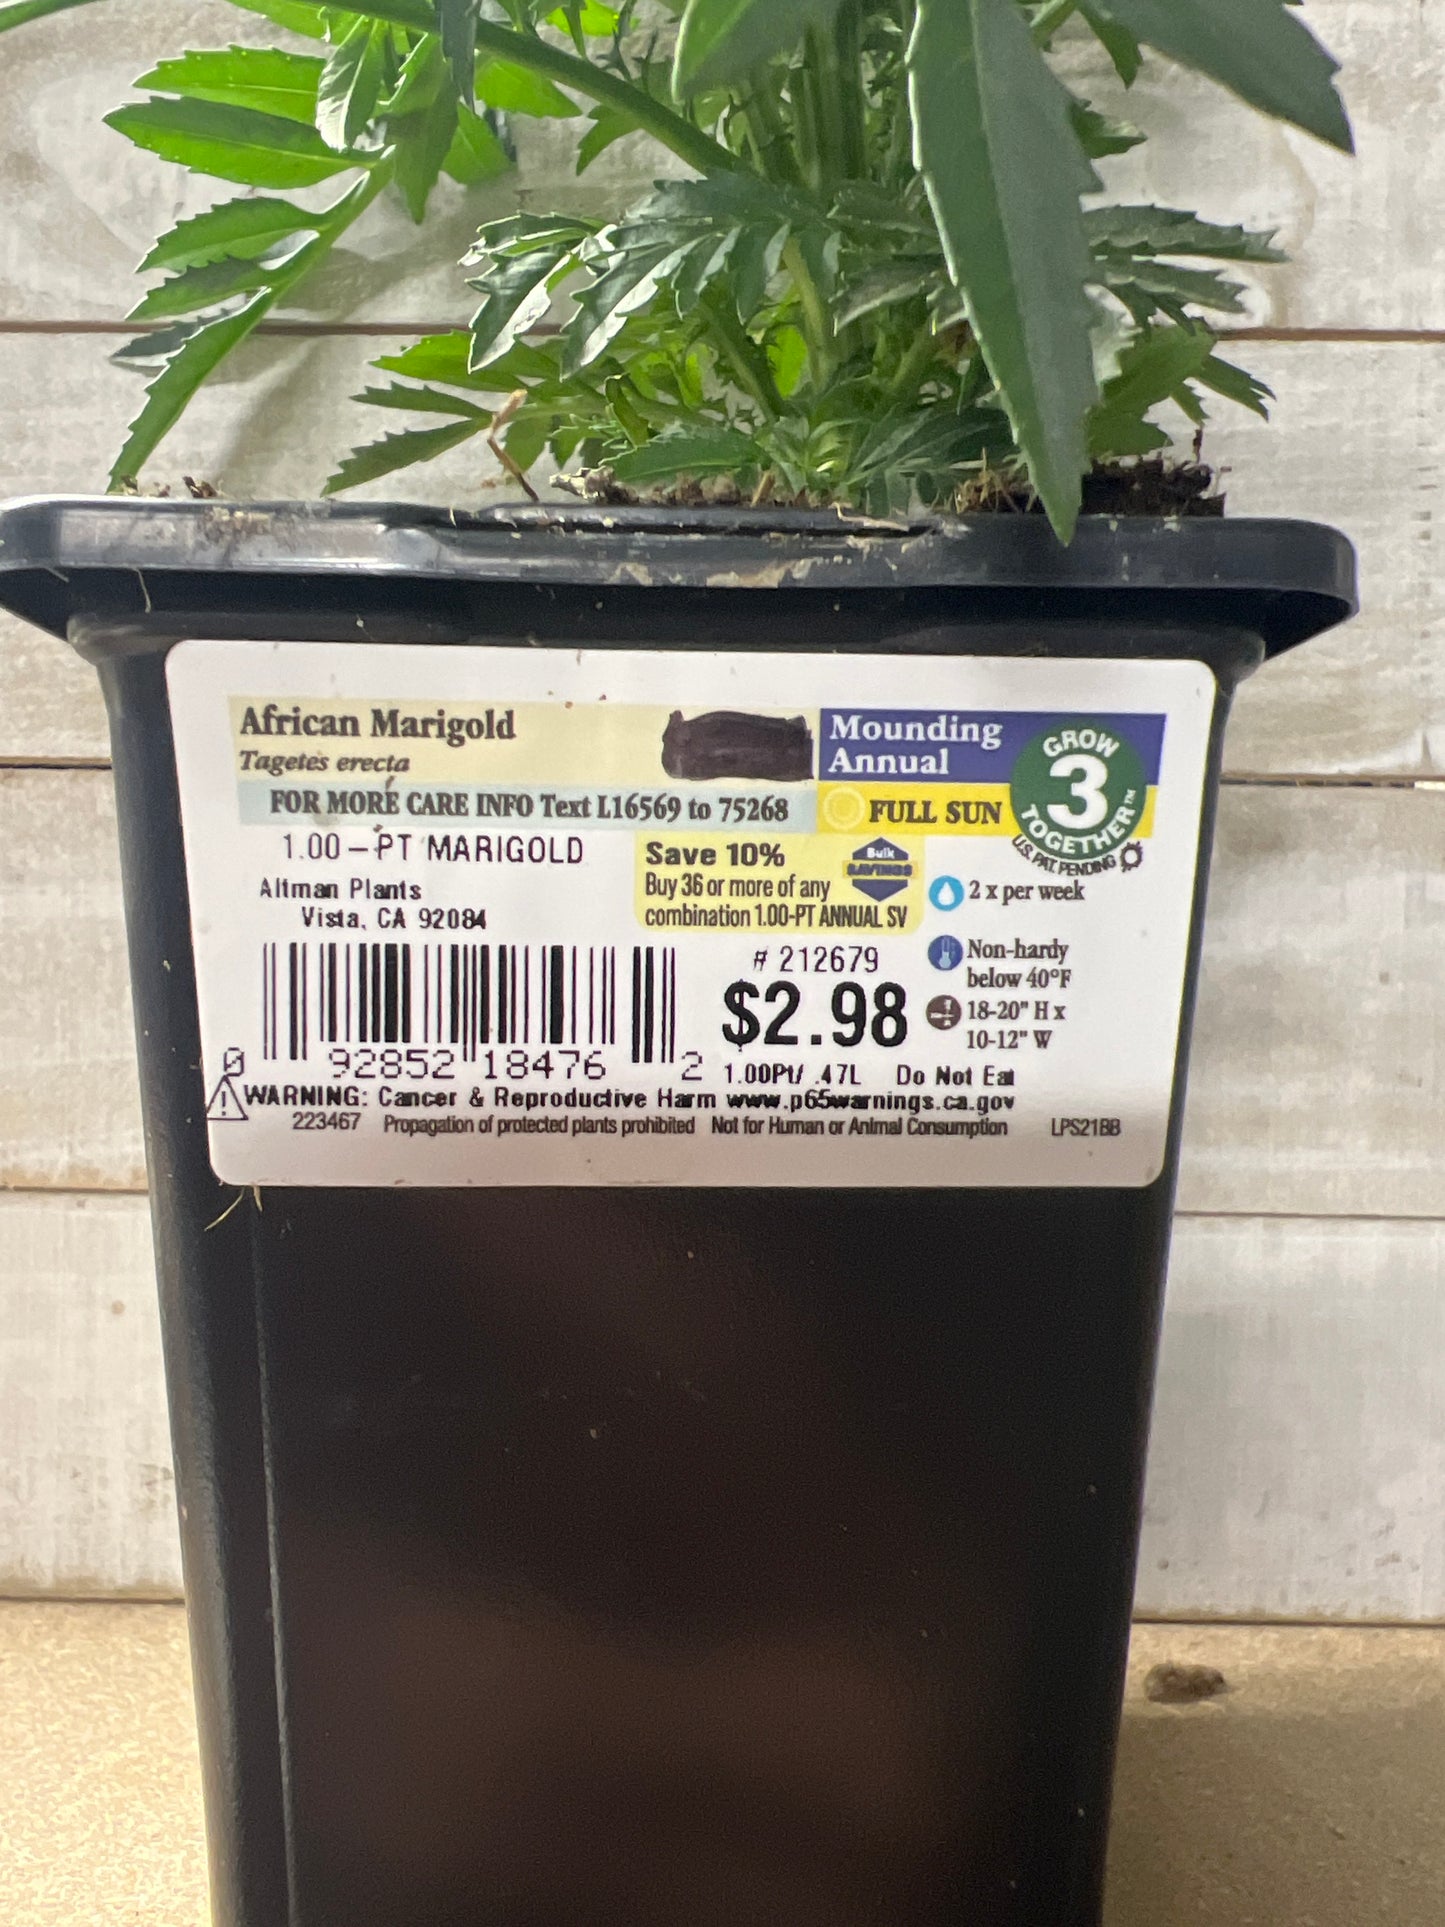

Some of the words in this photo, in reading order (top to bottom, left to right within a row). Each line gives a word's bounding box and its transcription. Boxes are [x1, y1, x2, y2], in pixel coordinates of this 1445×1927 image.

[240, 705, 361, 737] African
[370, 709, 516, 747] Marigold
[829, 714, 1003, 750] Mounding
[1043, 729, 1120, 757] GROW
[240, 751, 328, 776] Tagetes
[337, 755, 410, 774] erecta
[827, 749, 949, 775] Annual
[1047, 754, 1108, 829] 3
[270, 790, 321, 814] FOR
[327, 790, 399, 815] MORE
[406, 792, 469, 817] CARE
[476, 793, 534, 817] INFO
[540, 795, 592, 818] Text
[597, 794, 681, 821] L16569
[688, 797, 711, 820] to
[719, 797, 788, 822] 75268
[868, 799, 938, 824] FULL
[945, 801, 1003, 824] SUN
[427, 834, 584, 865] MARIGOLD
[645, 841, 717, 866] Save
[726, 842, 785, 867] 10%
[1058, 854, 1116, 877] PENDING
[260, 877, 339, 899] Altman
[350, 878, 421, 900] Plants
[645, 872, 678, 900] Buy
[681, 874, 702, 897] 36
[707, 878, 725, 897] or
[729, 879, 772, 898] more
[778, 874, 797, 898] of
[799, 880, 831, 902] any
[969, 880, 980, 899] 2
[985, 884, 998, 899] x
[1002, 885, 1033, 906] per
[1038, 879, 1085, 900] week
[378, 908, 406, 930] CA
[419, 909, 487, 931] 92084
[645, 904, 751, 927] combination
[755, 904, 815, 927] 1.00-PT
[819, 904, 883, 928] ANNUAL
[887, 906, 908, 929] SV
[754, 949, 767, 970] #
[779, 945, 879, 973] 212679
[967, 938, 1069, 965] Non-hardy
[967, 967, 1022, 988] below
[1026, 967, 1072, 989] 40°F
[722, 979, 908, 1053] $2.98
[968, 1001, 1028, 1020] 18-20"
[1034, 1001, 1048, 1020] H
[1054, 1005, 1066, 1020] x
[967, 1030, 1028, 1049] 10-12"
[1033, 1030, 1052, 1049] W
[223, 1047, 245, 1077] 0
[328, 1049, 455, 1079] 92852
[484, 1050, 607, 1080] 18476
[681, 1051, 703, 1081] 2
[896, 1065, 925, 1086] Do
[935, 1065, 972, 1086] Not
[983, 1065, 1015, 1086] Eat
[243, 1085, 368, 1107] WARNING:
[378, 1087, 457, 1107] Cancer
[470, 1088, 485, 1107] &
[494, 1087, 647, 1110] Reproductive
[657, 1088, 716, 1108] Harm
[726, 1088, 1015, 1115] www.p65warnings.ca.gov
[292, 1112, 361, 1130] 223467
[384, 1114, 474, 1136] Propagation
[478, 1114, 494, 1133] of
[497, 1114, 569, 1137] protected
[571, 1115, 618, 1136] plants
[621, 1115, 696, 1137] prohibited
[711, 1116, 740, 1134] Not
[743, 1116, 763, 1134] for
[768, 1116, 825, 1135] Human
[828, 1120, 845, 1136] or
[848, 1117, 902, 1135] Animal
[907, 1117, 1008, 1139] Consumption
